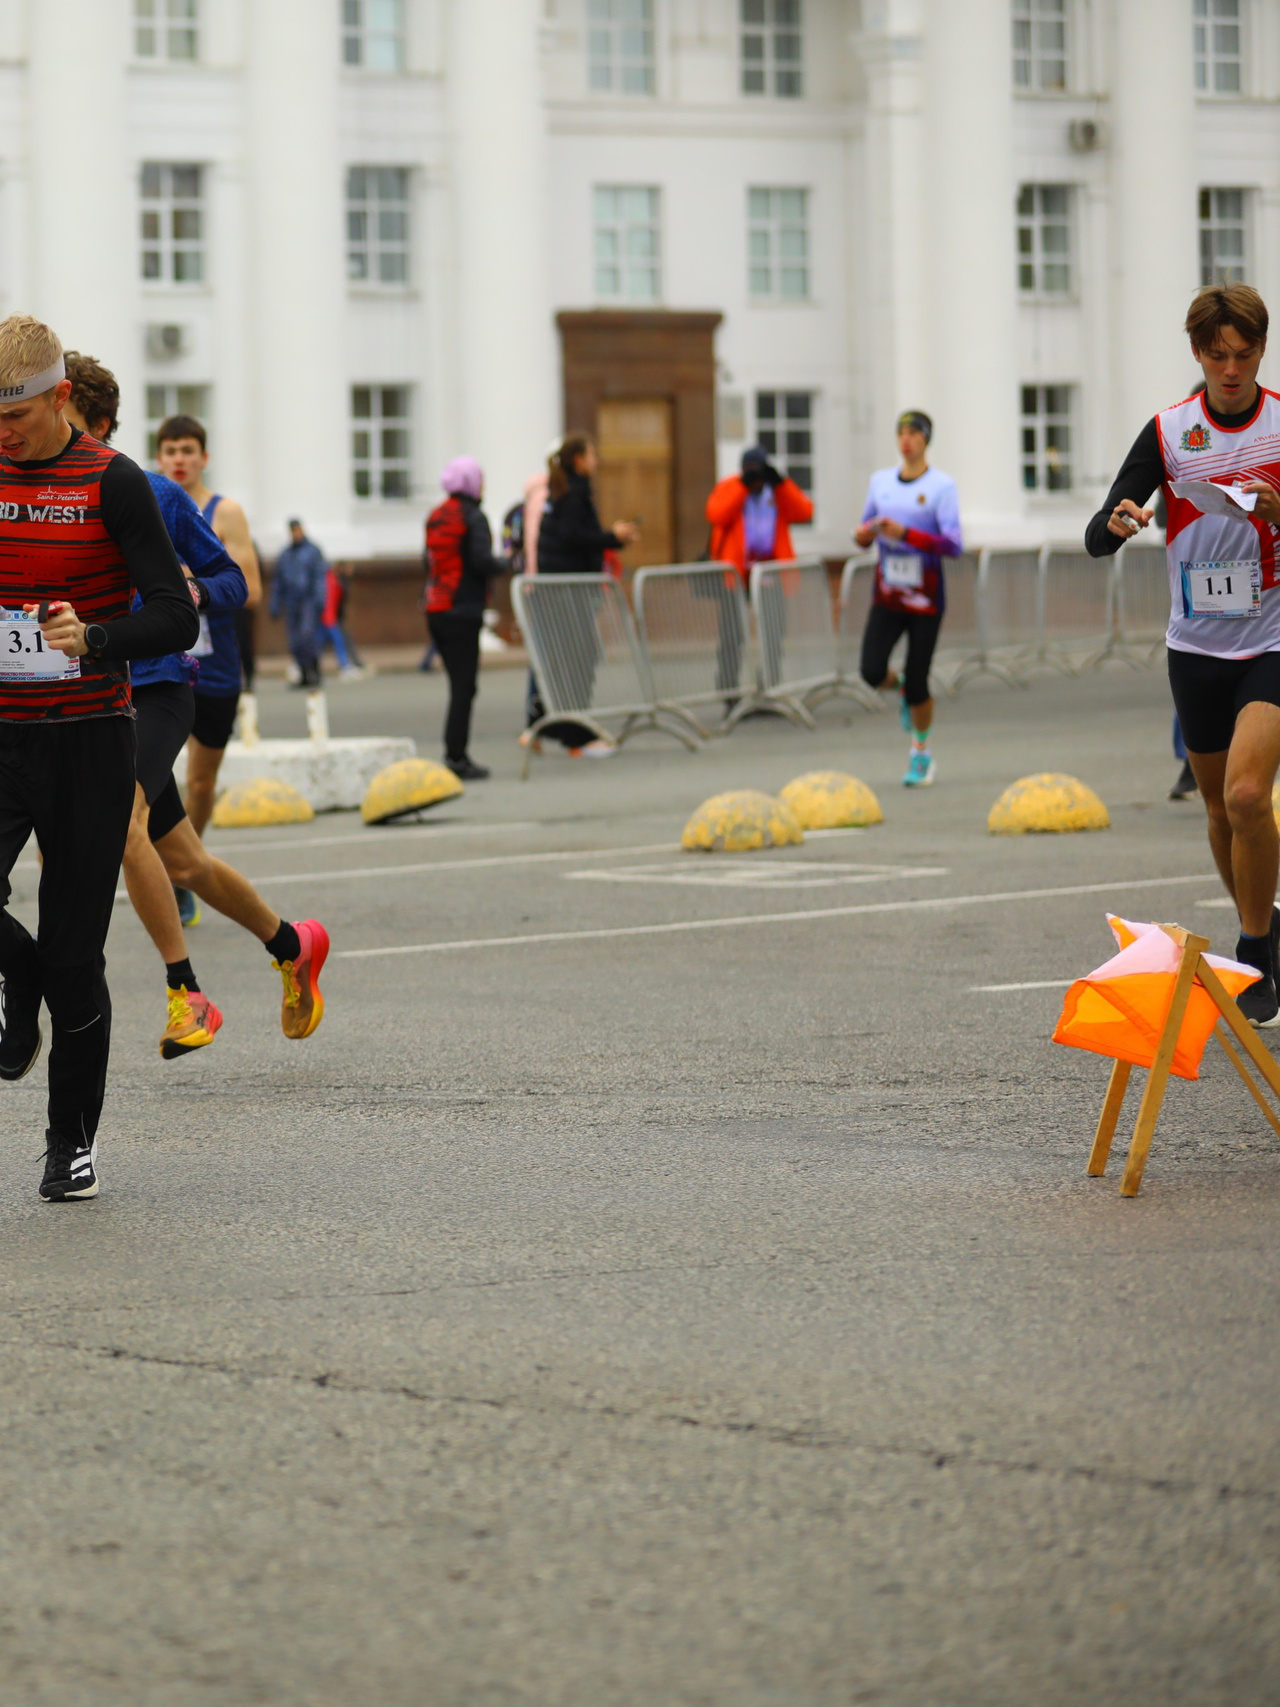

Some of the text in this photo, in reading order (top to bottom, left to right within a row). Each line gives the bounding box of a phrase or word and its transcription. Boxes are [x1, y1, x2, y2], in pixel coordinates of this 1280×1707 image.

[37, 493, 88, 502] Saint-Petersburg
[26, 503, 88, 524] WEST
[1205, 576, 1234, 595] 1.1
[8, 630, 45, 653] 3.1
